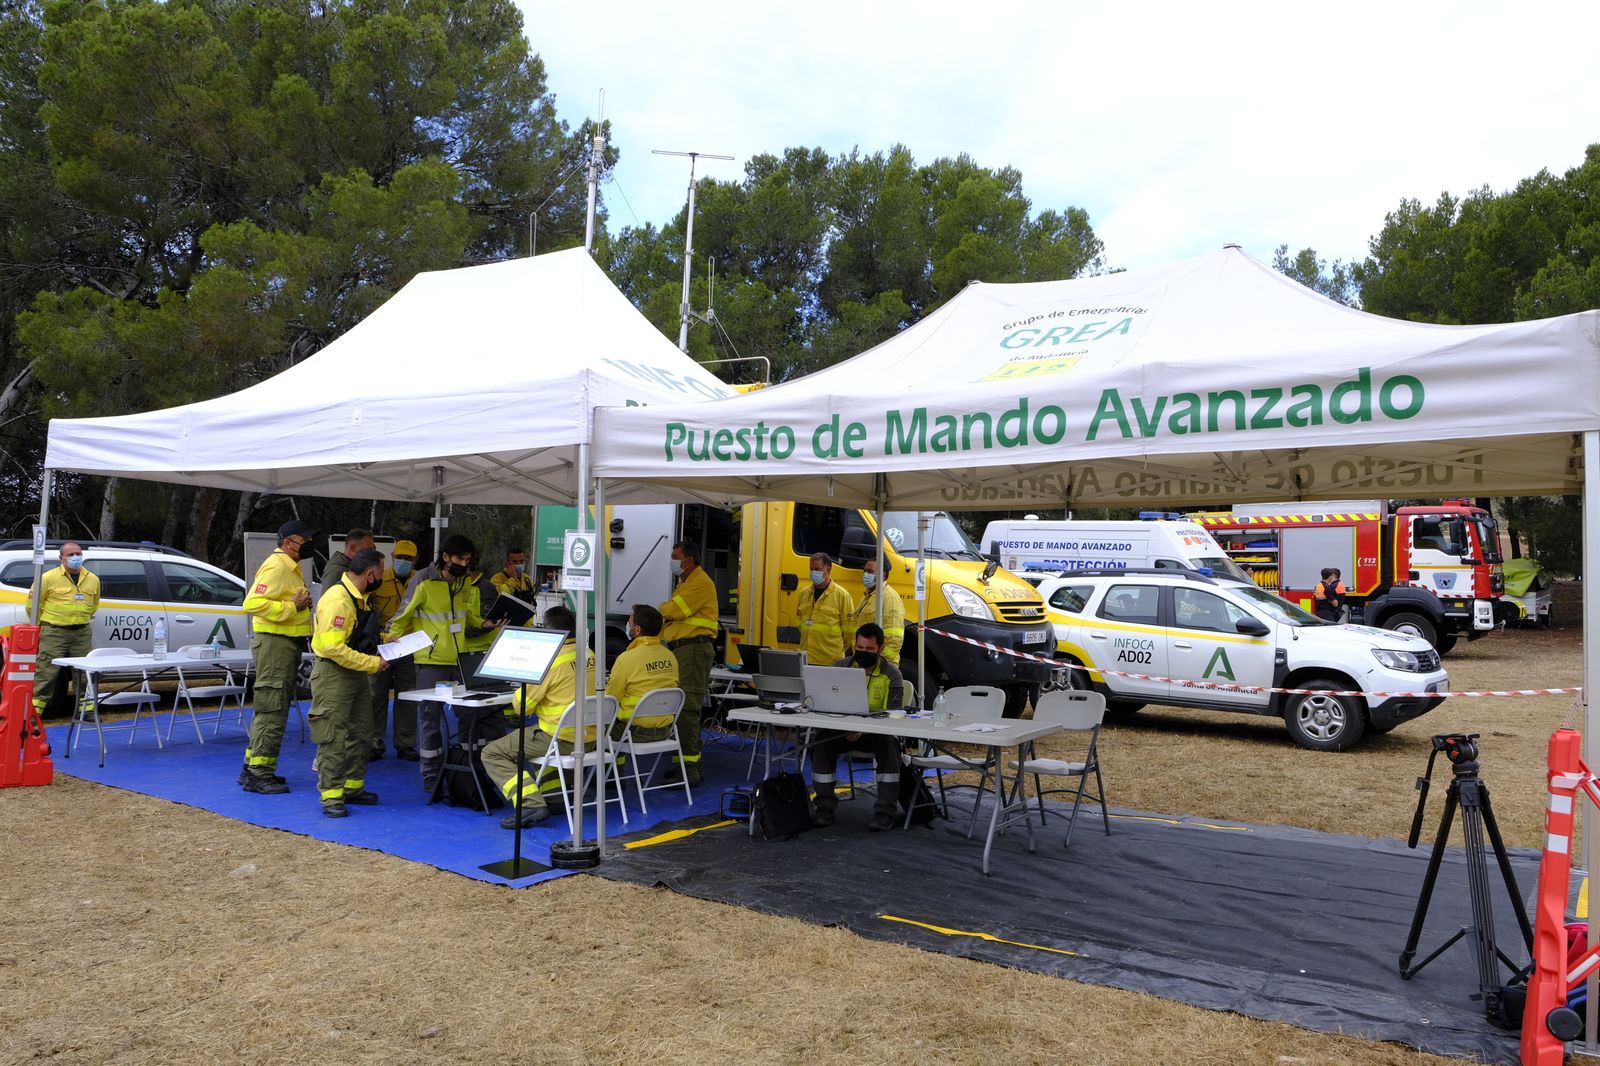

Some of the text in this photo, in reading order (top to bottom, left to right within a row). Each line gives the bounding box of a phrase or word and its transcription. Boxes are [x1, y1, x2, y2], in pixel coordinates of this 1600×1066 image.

[1002, 314, 1045, 331] Grupo
[1048, 310, 1065, 319] de
[999, 317, 1133, 349] GREA
[664, 366, 1426, 462] Puesto de Mando Avanzado
[998, 540, 1132, 551] PUESTO DE MANDO AVANZADO
[104, 615, 154, 627] INFOCA
[108, 627, 150, 641] AD01
[1114, 637, 1155, 650] INFOCA
[1117, 649, 1152, 665] AD02
[645, 660, 673, 672] INFOCA
